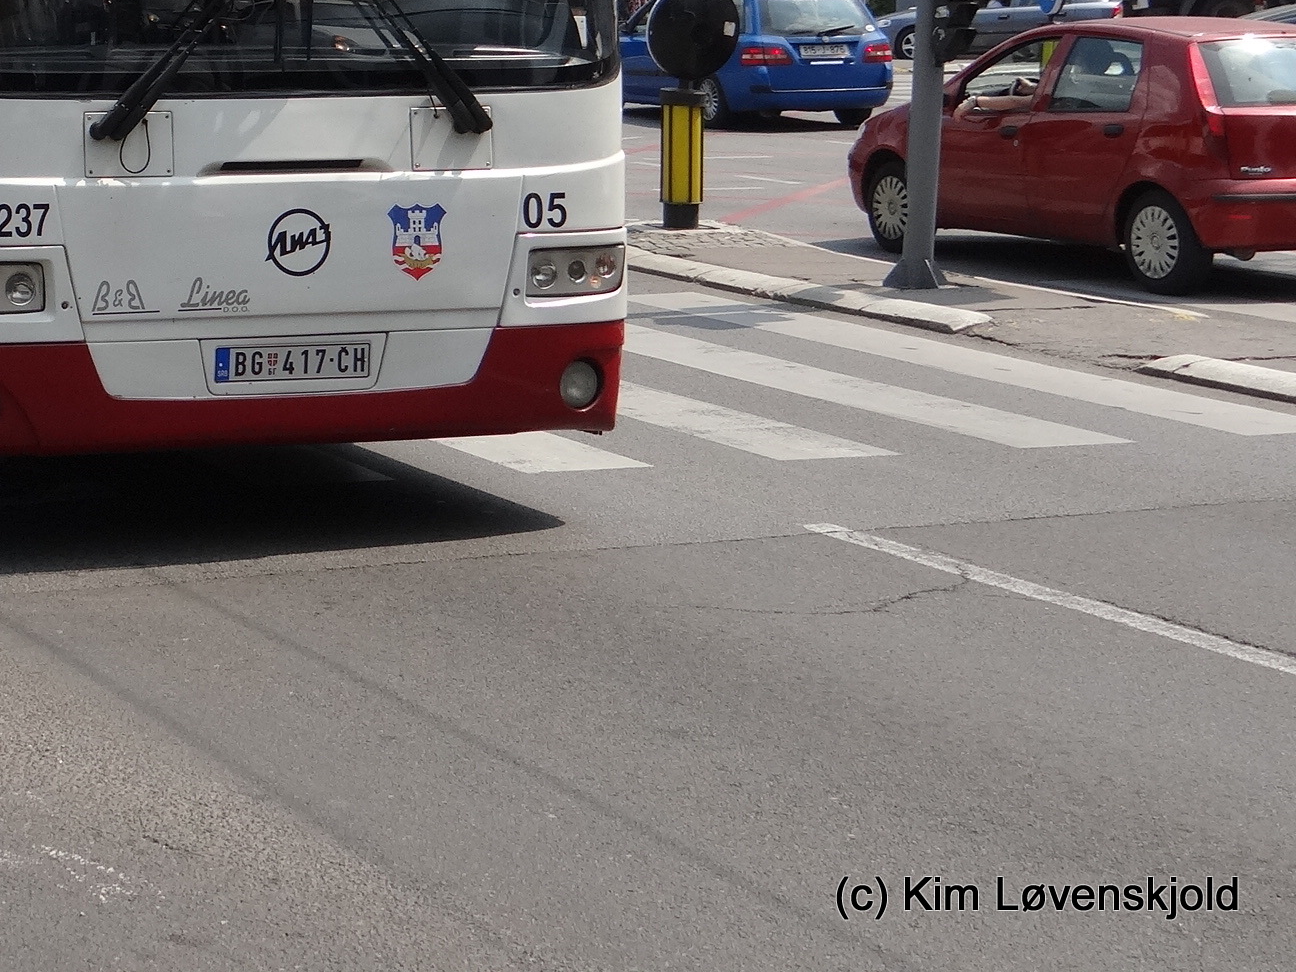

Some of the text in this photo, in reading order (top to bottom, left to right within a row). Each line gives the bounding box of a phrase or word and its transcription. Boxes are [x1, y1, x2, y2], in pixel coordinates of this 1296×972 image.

[522, 192, 567, 229] 05
[179, 276, 251, 310] Linea
[234, 350, 264, 377] BG
